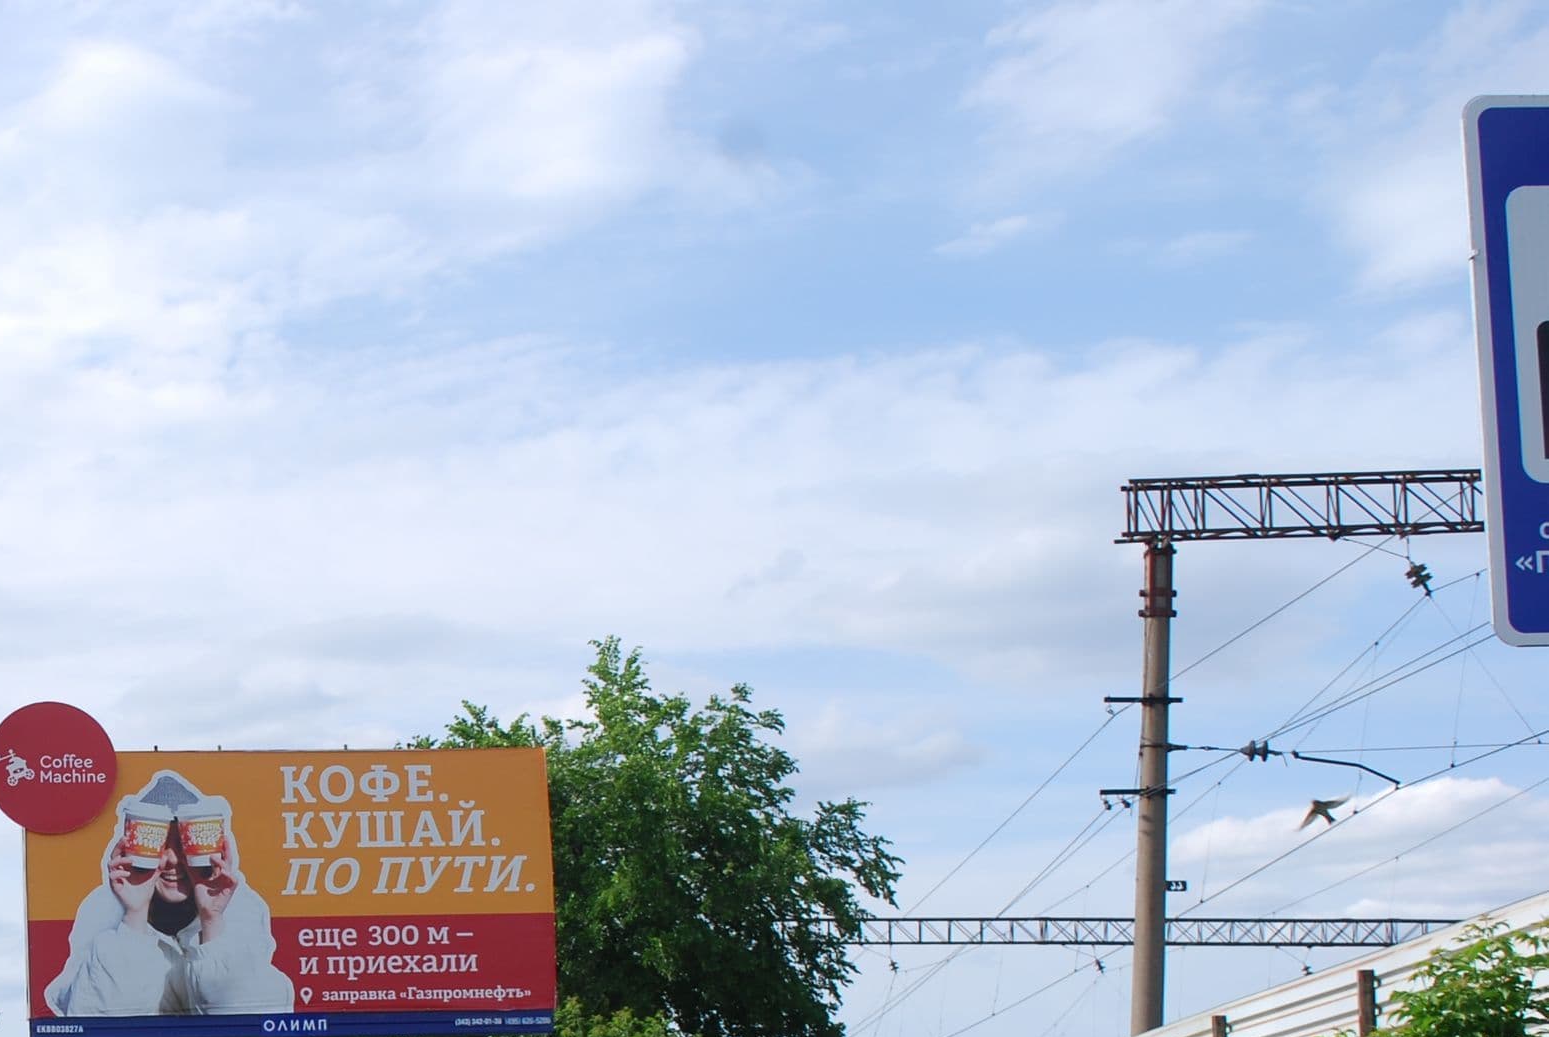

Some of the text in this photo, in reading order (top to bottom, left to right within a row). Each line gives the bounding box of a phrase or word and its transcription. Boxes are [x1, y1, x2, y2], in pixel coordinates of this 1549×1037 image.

[40, 753, 93, 769] Coffee
[40, 769, 107, 783] Machine
[280, 765, 449, 803] КОФЕ.
[282, 800, 500, 848] КУШАЙ.
[281, 855, 536, 896] ПО ПУТИ.
[298, 927, 358, 949] еще
[368, 925, 419, 946] 300
[427, 926, 449, 944] м
[299, 953, 478, 981] и приехали
[322, 985, 532, 1004] заправка «Газпромнефть»
[263, 1018, 327, 1032] ОЛИМП
